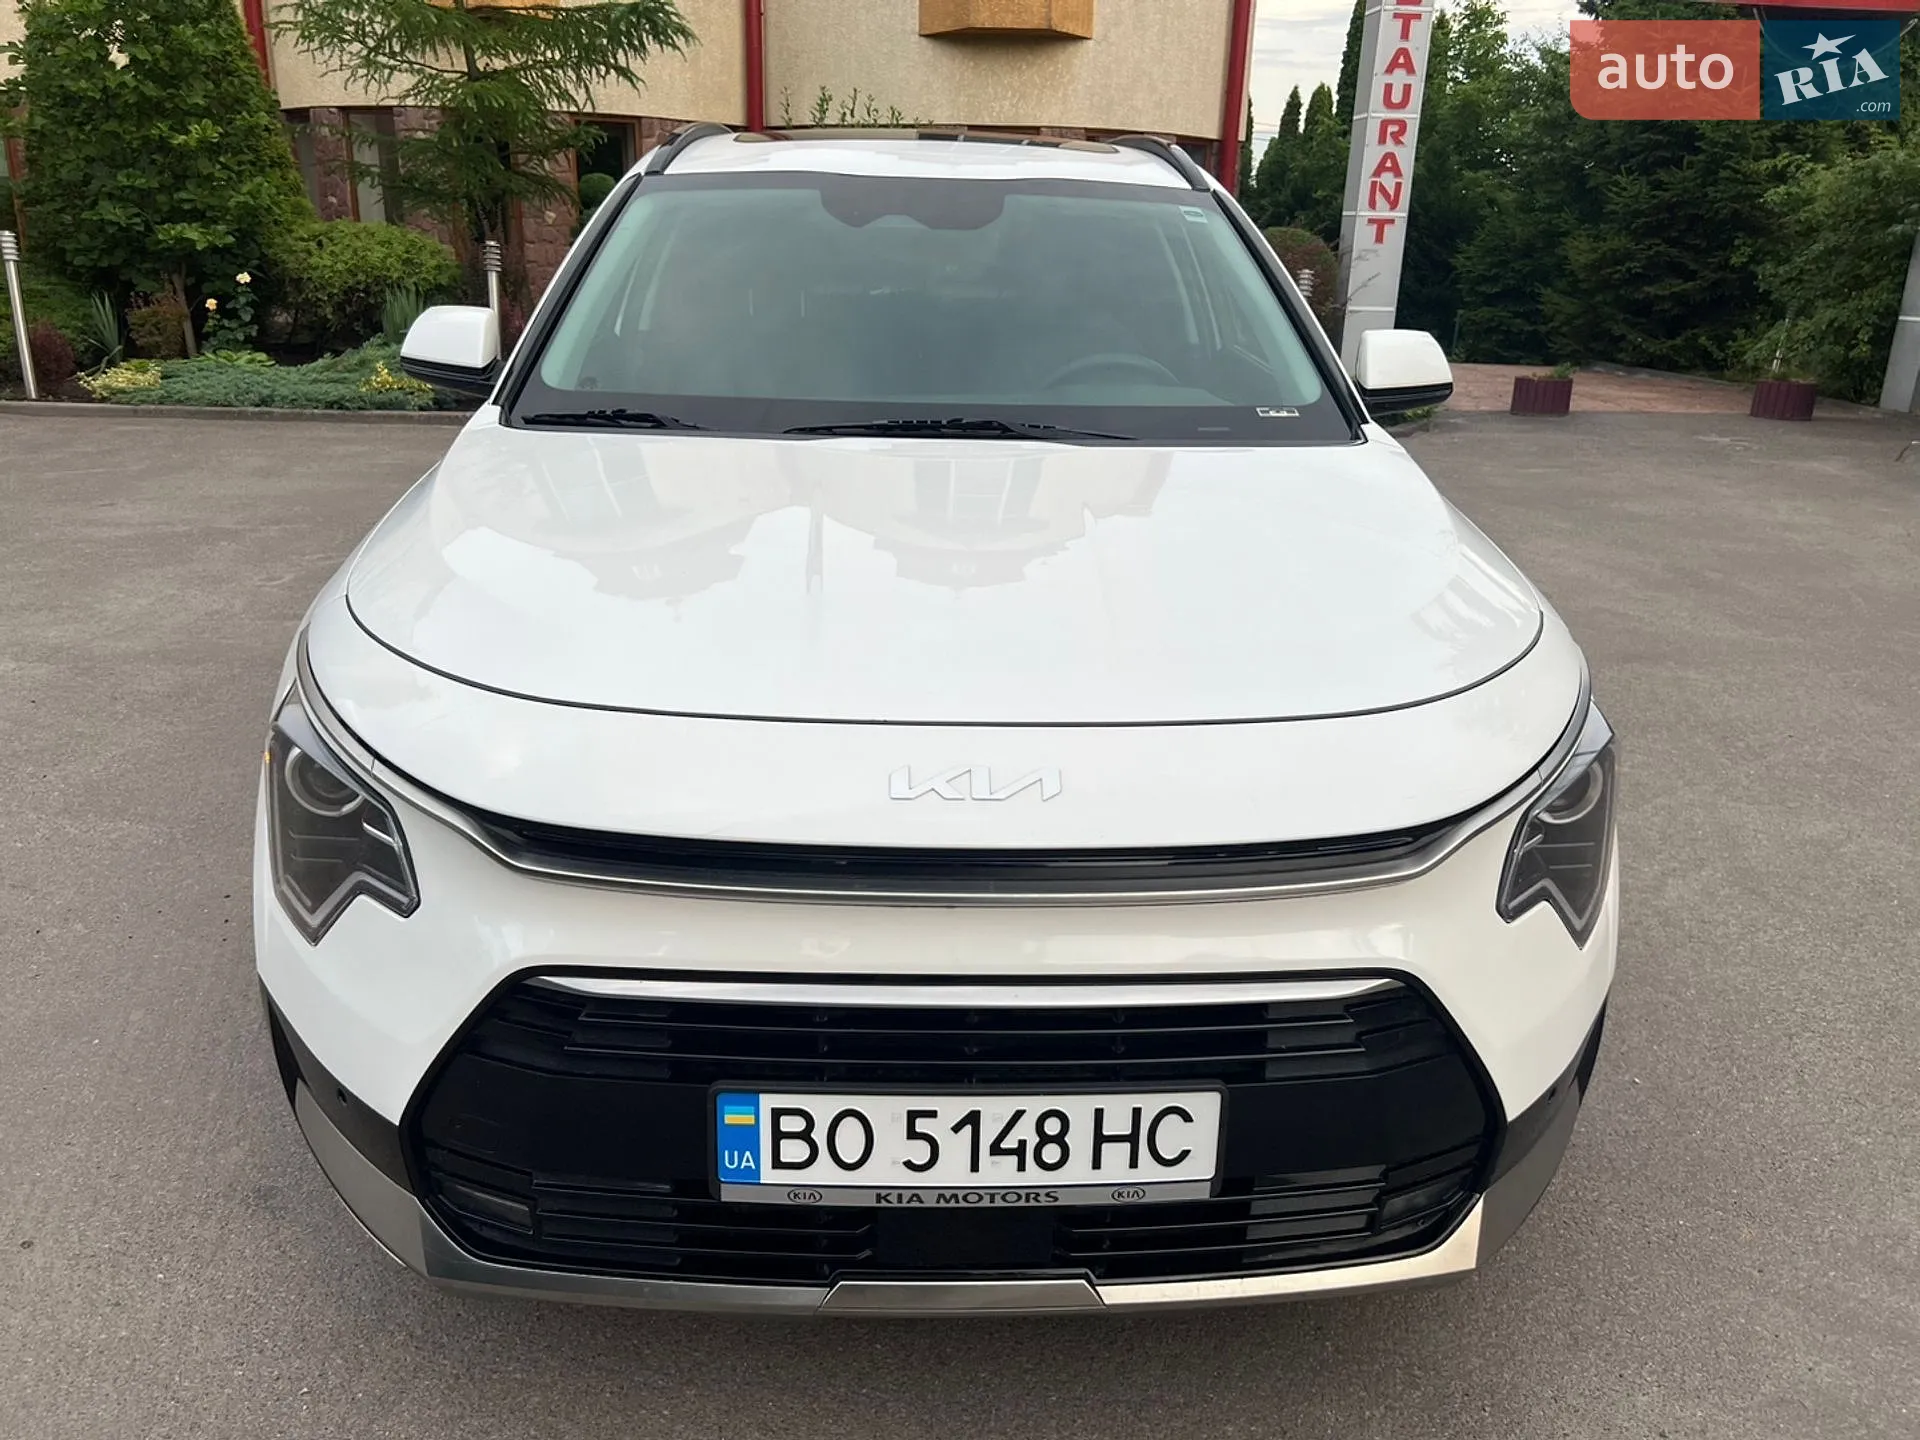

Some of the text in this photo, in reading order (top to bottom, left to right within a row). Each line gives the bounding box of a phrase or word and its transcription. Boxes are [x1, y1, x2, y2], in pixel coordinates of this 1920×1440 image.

[1367, 0, 1423, 244] TAURANT
[888, 764, 1062, 802] KIA
[770, 1105, 1194, 1173] BO 5148 HC
[724, 1150, 756, 1169] UA
[791, 1190, 819, 1201] KIA
[875, 1191, 1060, 1205] KIA MOTORS
[1115, 1189, 1142, 1200] KIA
